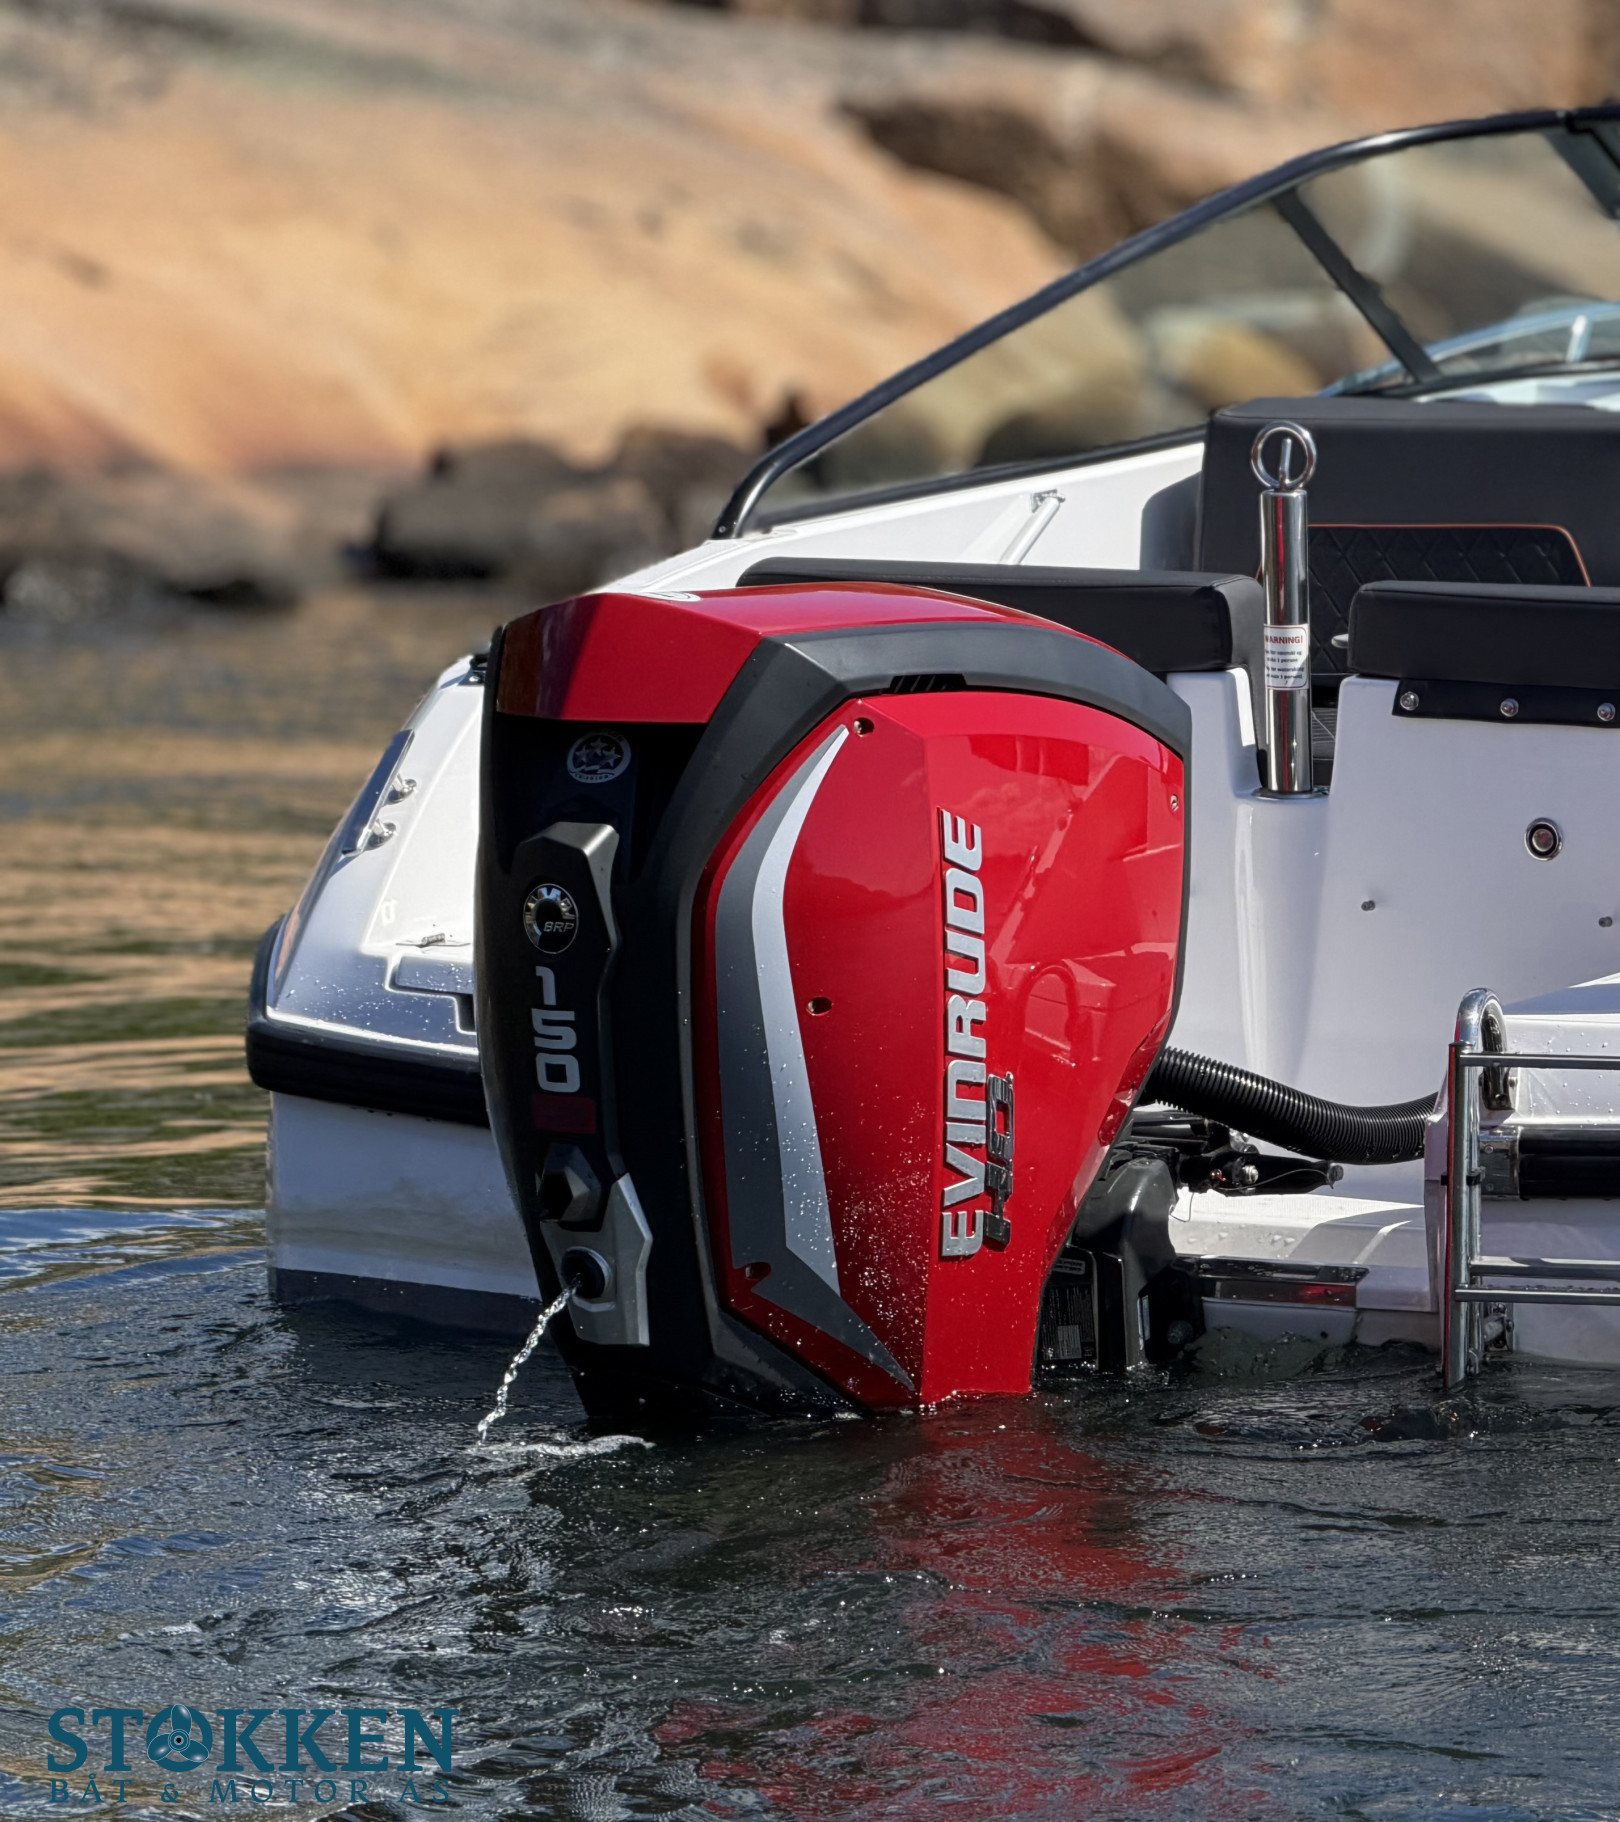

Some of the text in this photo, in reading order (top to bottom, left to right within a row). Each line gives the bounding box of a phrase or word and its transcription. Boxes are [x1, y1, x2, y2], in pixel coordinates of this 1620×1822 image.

[543, 921, 575, 933] BRP
[531, 965, 581, 1093] 150
[939, 807, 987, 1259] EVINRUDE
